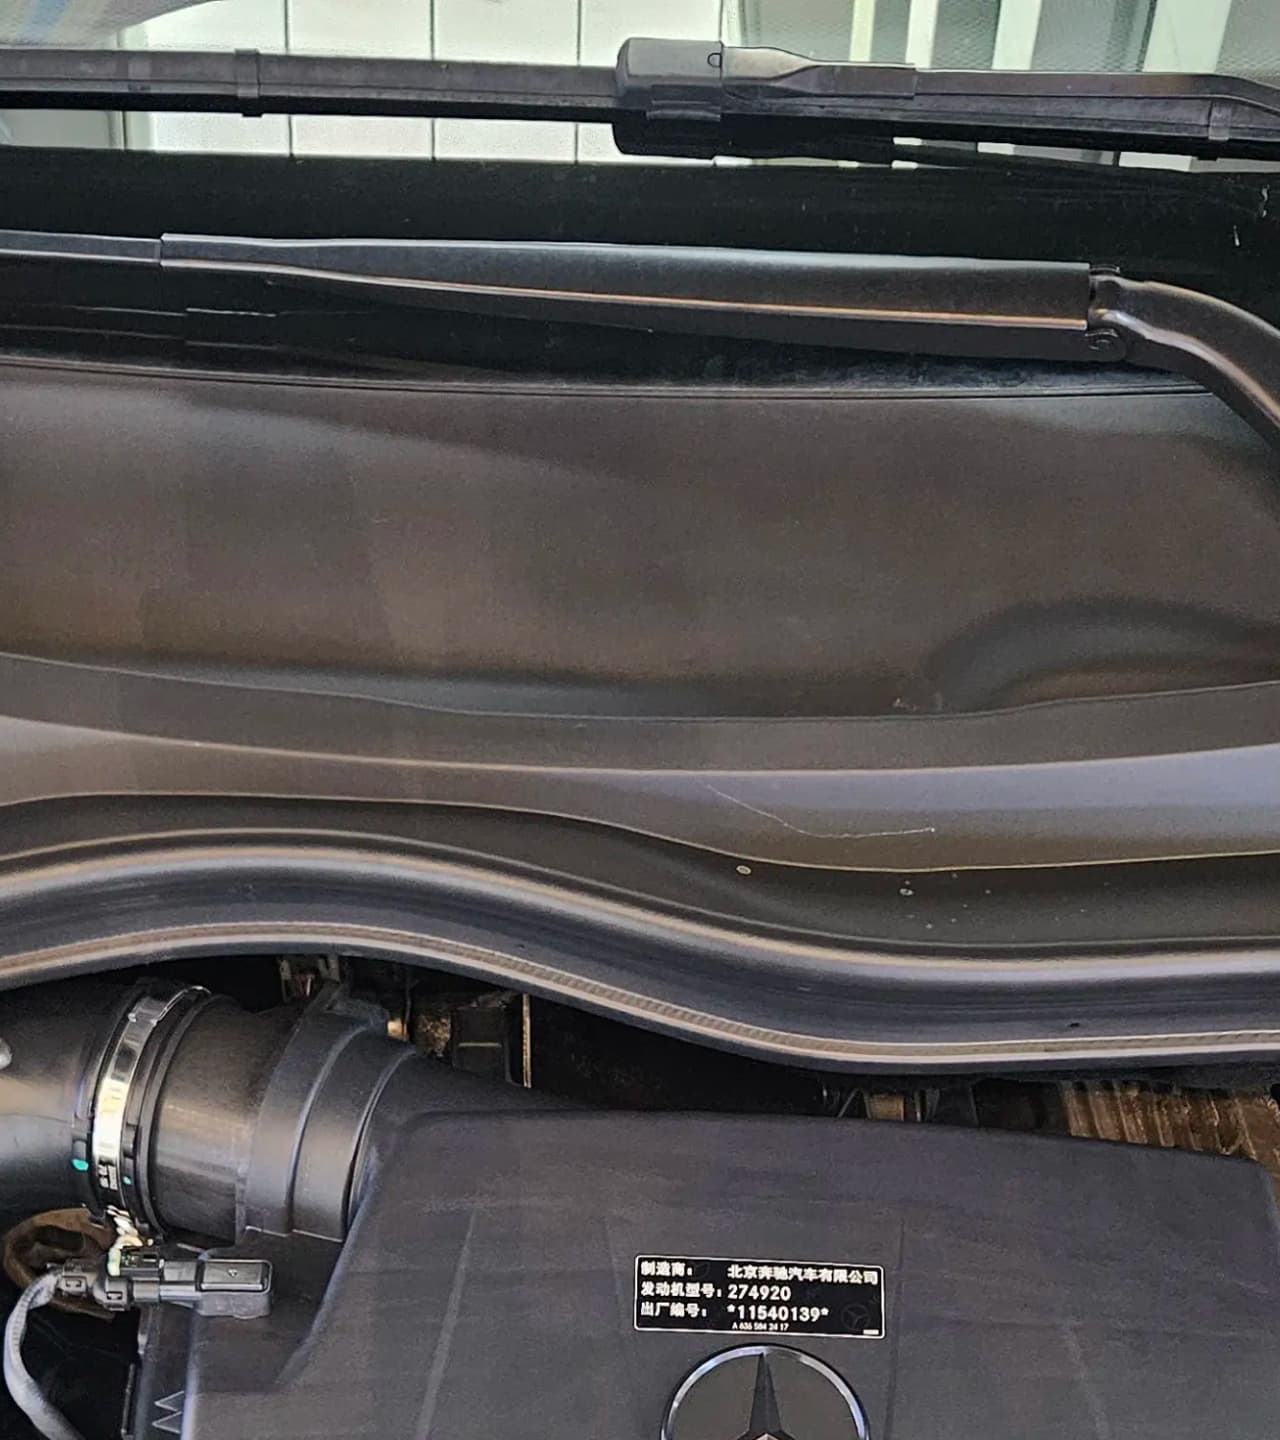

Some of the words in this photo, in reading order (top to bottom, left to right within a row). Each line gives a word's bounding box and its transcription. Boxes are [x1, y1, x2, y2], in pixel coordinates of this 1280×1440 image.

[727, 1264, 879, 1285] 北京奔驰汽车有限公司
[728, 1285, 792, 1301] 274920
